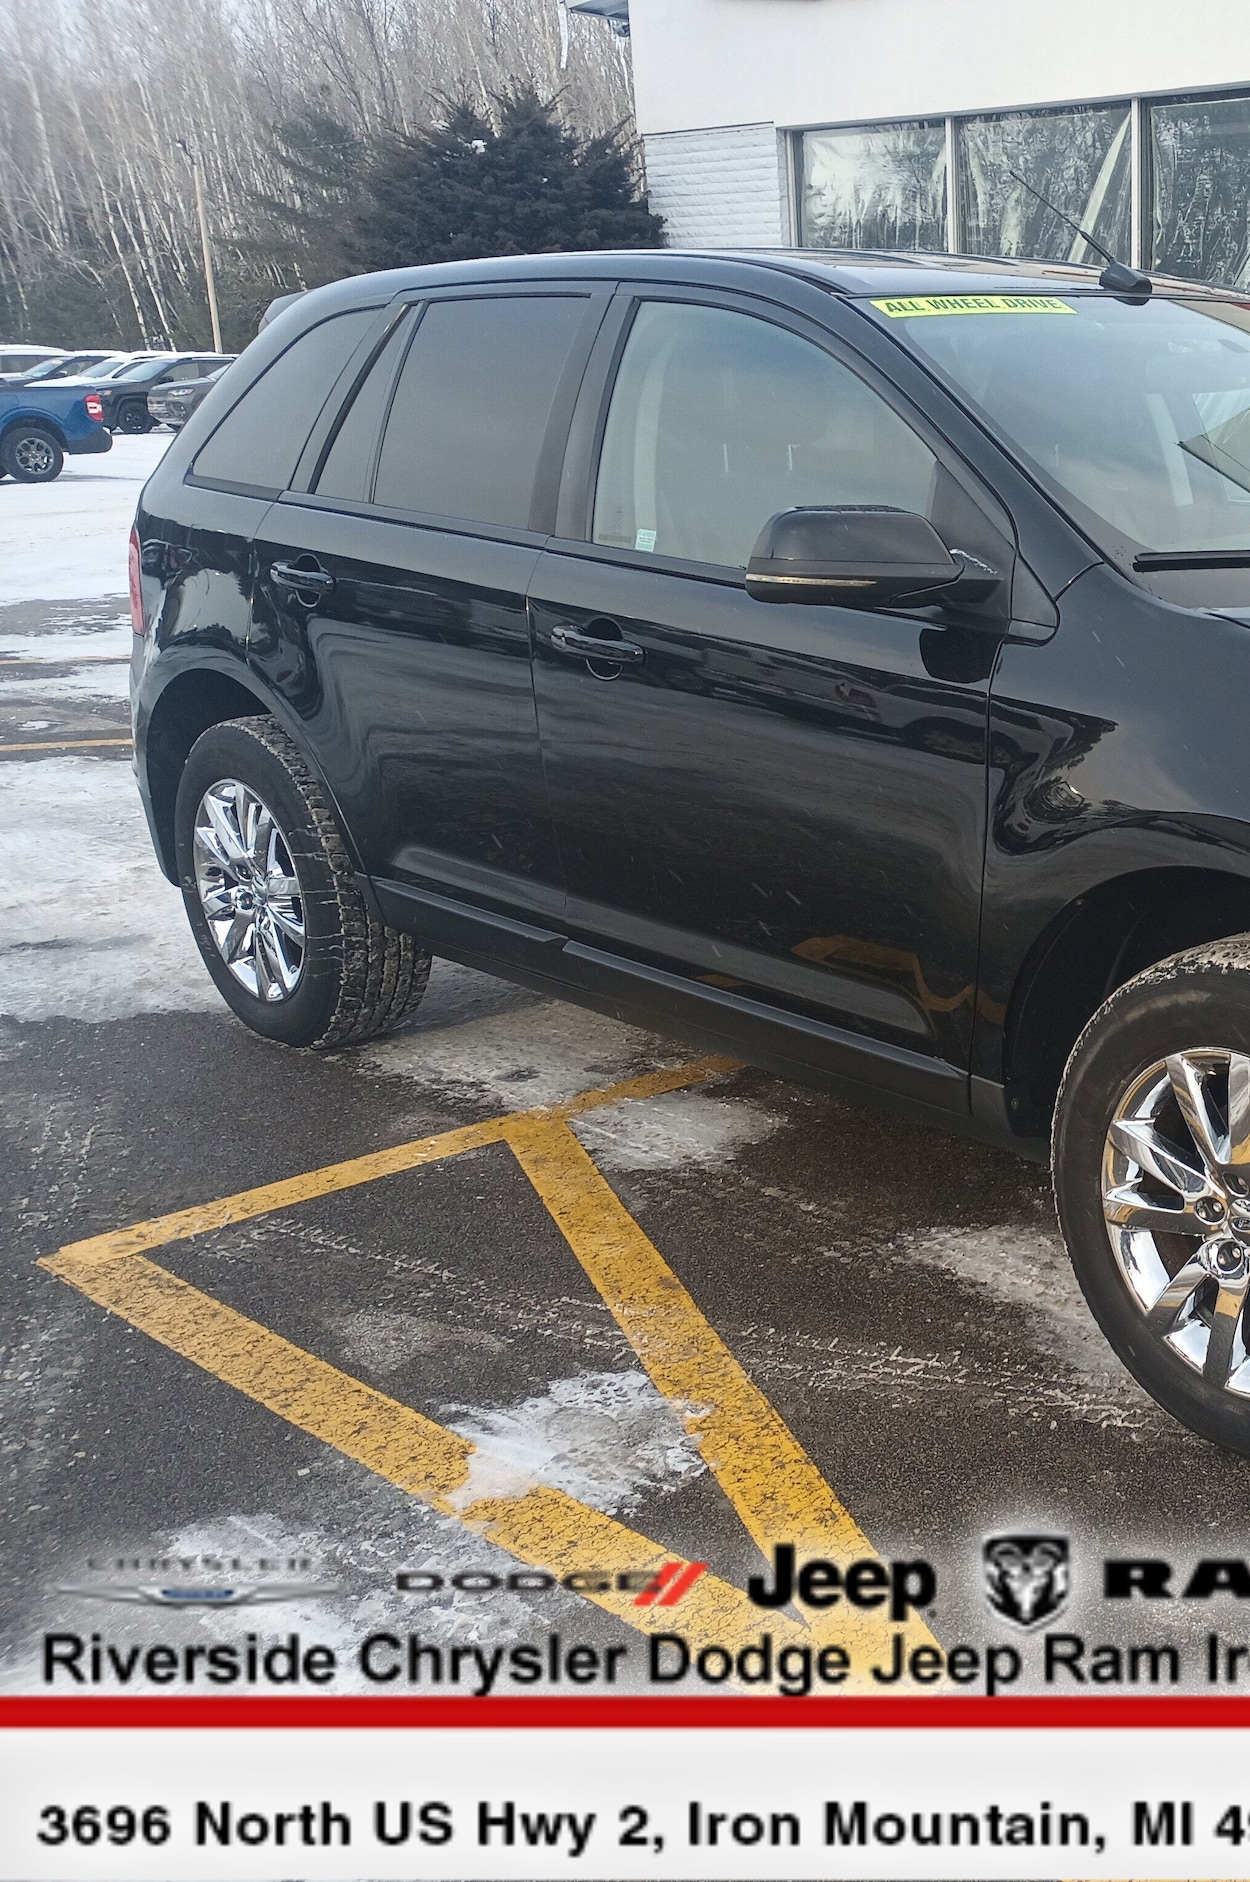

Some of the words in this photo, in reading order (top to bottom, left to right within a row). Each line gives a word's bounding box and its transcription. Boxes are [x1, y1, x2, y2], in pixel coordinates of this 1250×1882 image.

[885, 300, 925, 313] ALL
[928, 298, 1000, 311] WHEEL
[1002, 298, 1062, 309] DRIVE
